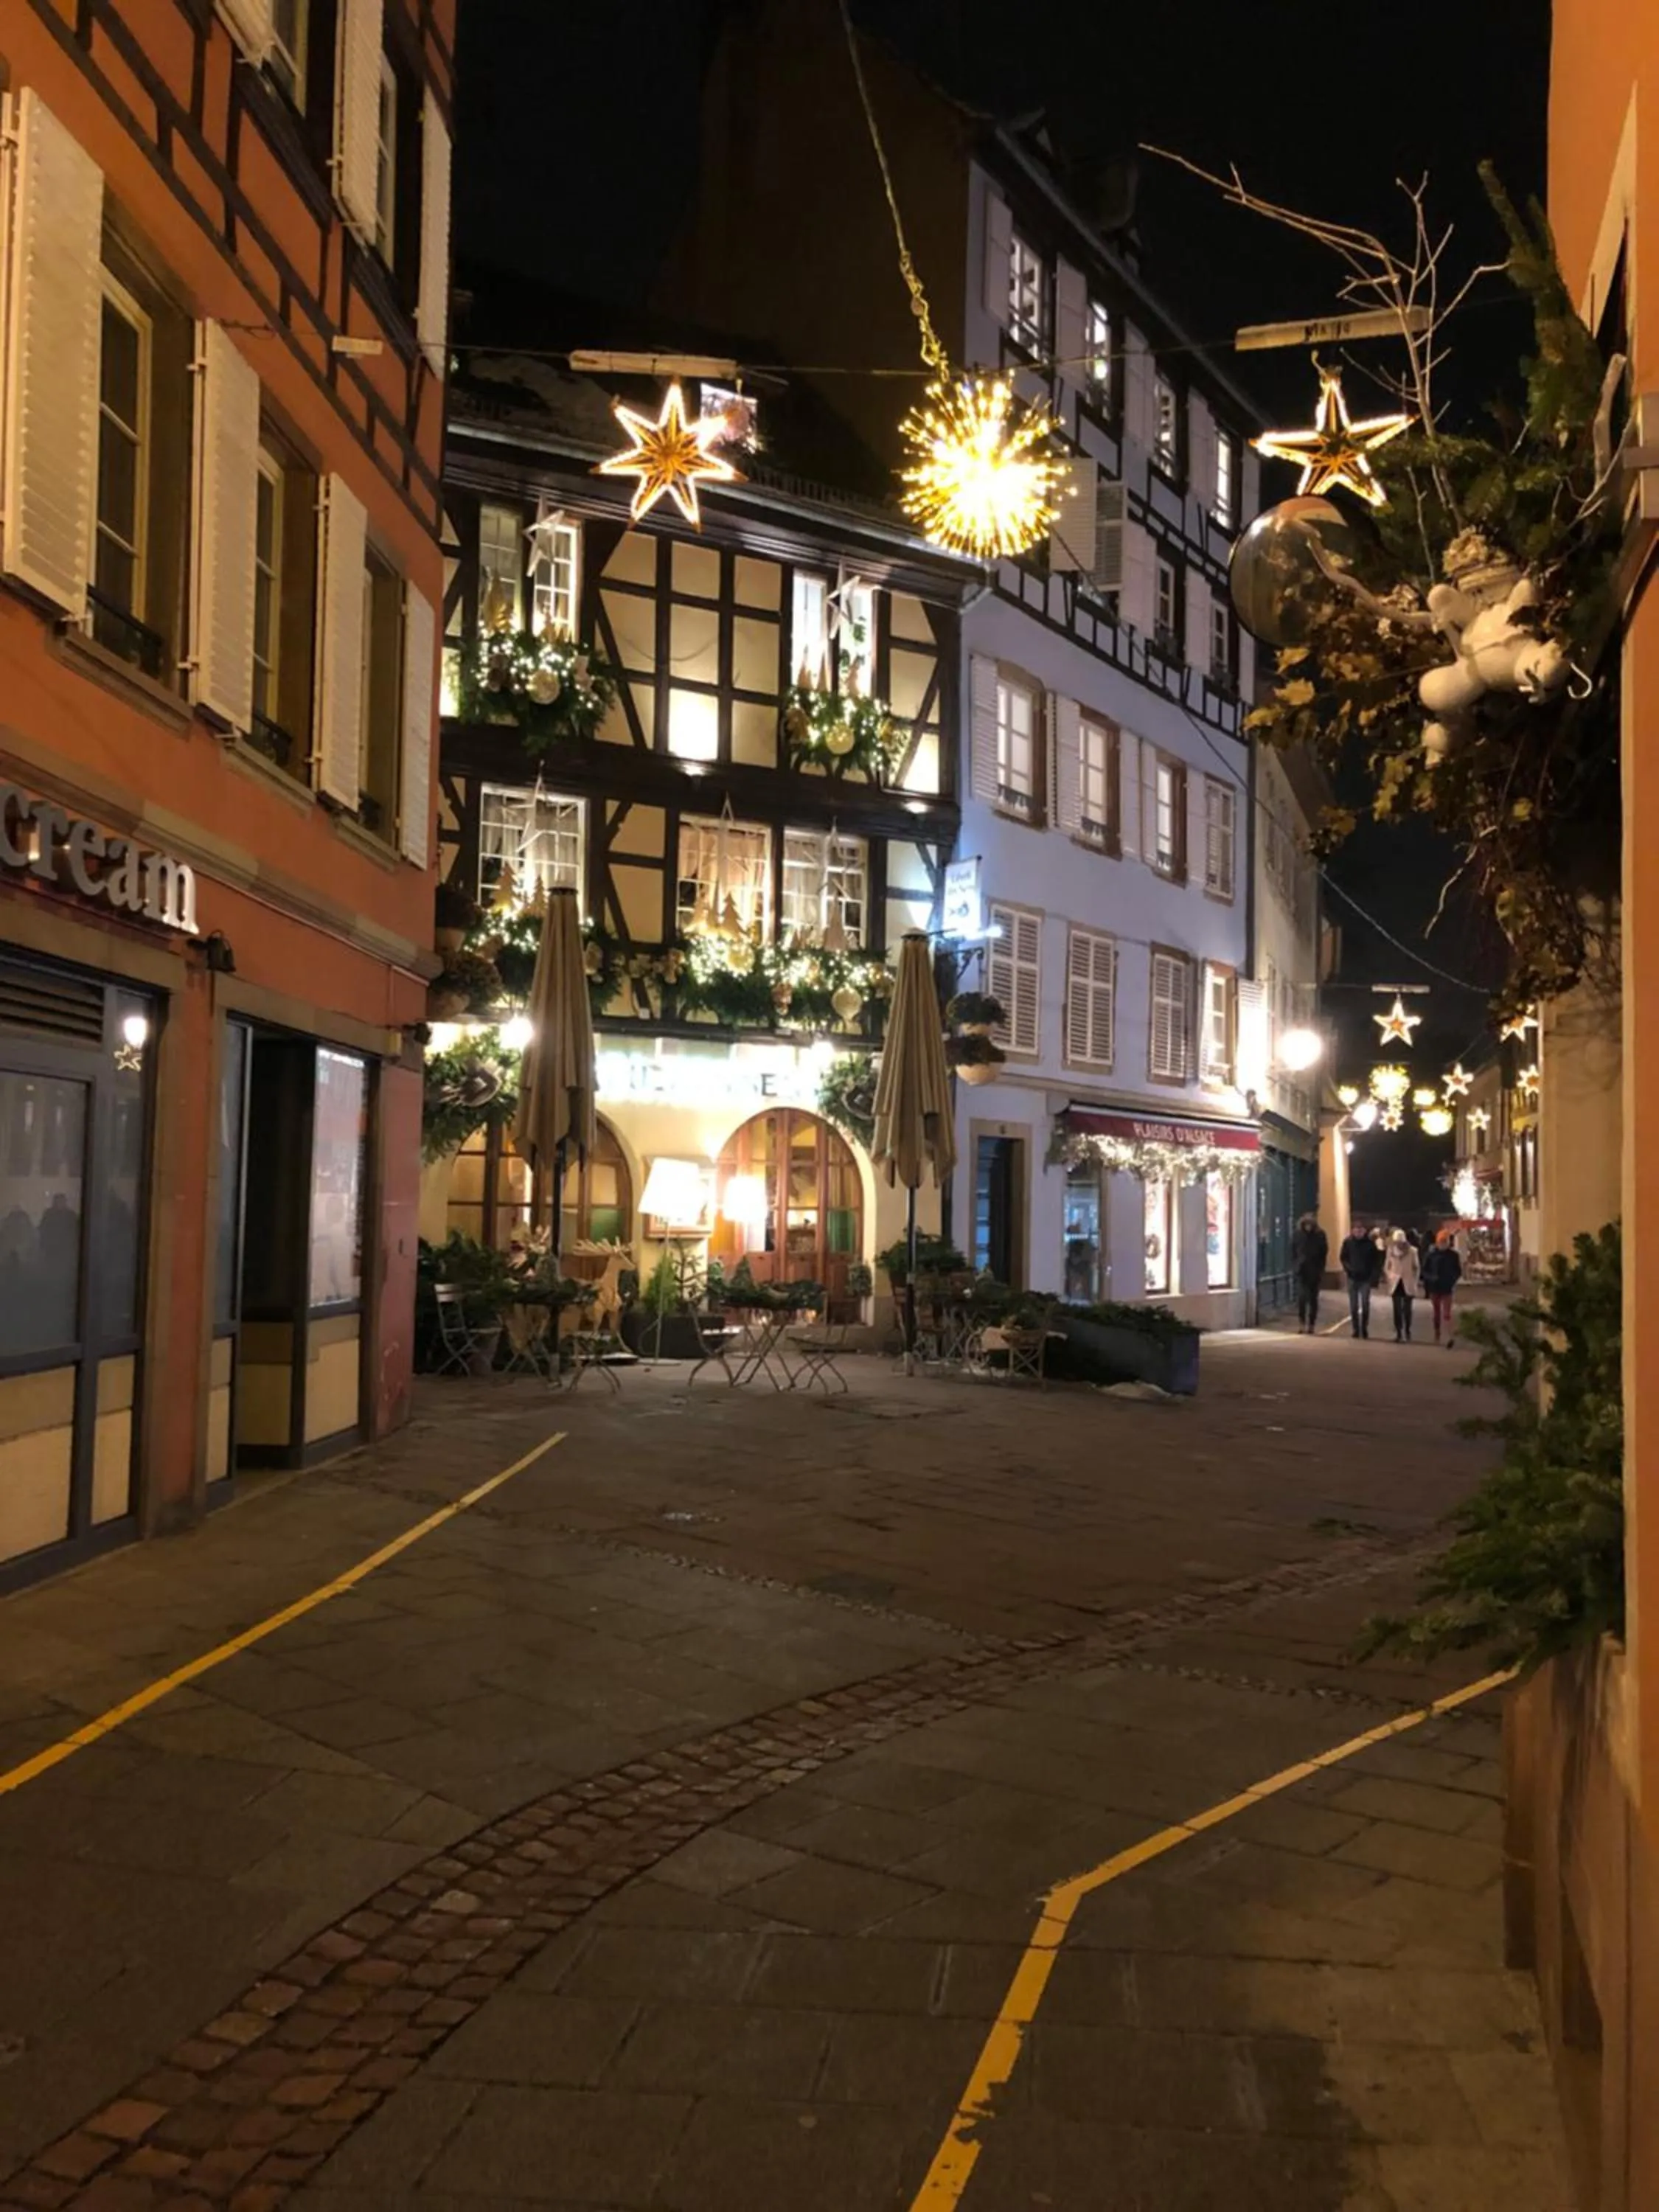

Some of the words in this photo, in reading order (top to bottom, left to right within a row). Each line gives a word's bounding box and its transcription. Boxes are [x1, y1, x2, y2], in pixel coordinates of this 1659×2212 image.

[0, 781, 200, 935] cream
[1133, 1121, 1174, 1141] PLAISIRS
[1176, 1126, 1215, 1146] D'ALSACE
